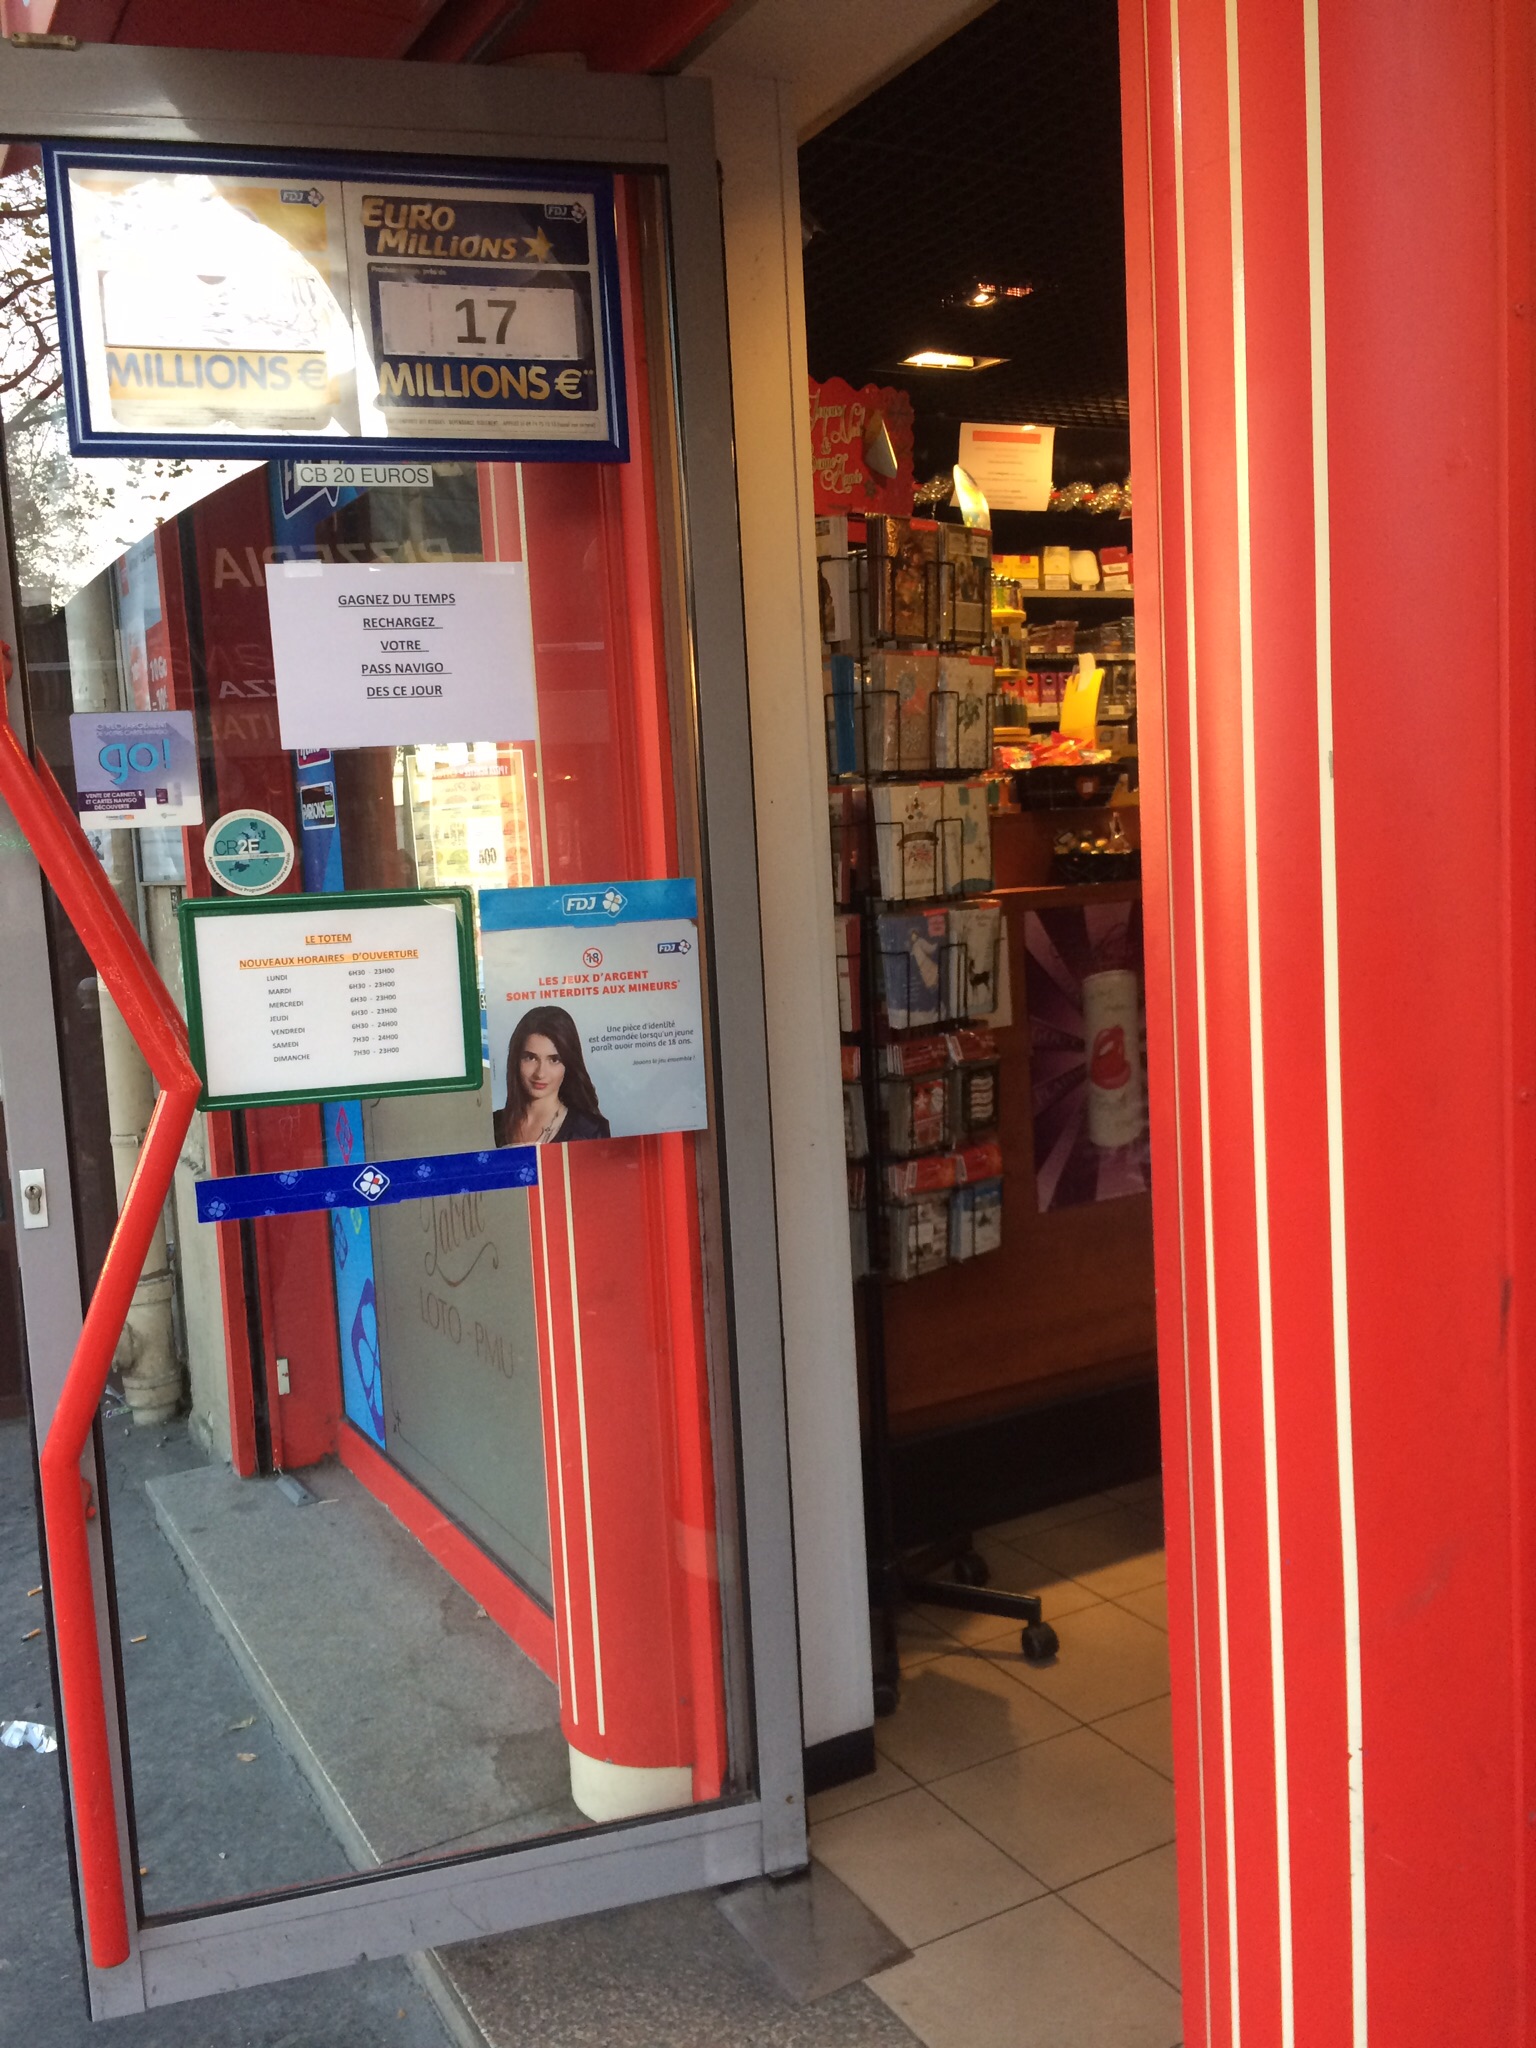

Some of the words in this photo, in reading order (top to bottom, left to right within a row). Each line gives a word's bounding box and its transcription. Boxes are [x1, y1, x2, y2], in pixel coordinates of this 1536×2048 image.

[283, 191, 303, 202] FDJ
[362, 198, 456, 231] EURO
[548, 206, 567, 217] FDJ
[455, 298, 517, 345] 17
[108, 351, 292, 390] MILLIONS
[379, 361, 550, 400] MILLIONS
[300, 466, 327, 484] CB
[334, 466, 355, 484] 20
[361, 467, 430, 484] EUROS
[338, 594, 389, 606] GAGNEZ
[392, 594, 411, 605] DU
[414, 592, 456, 605] TEMPS
[363, 616, 435, 629] RECHARGEZ
[380, 640, 422, 652] VOTRE
[361, 662, 392, 675] PASS
[394, 662, 444, 674] NAVIGO
[366, 686, 390, 698] DES
[392, 686, 408, 697] CE
[410, 684, 442, 697] JOUR
[98, 738, 172, 786] go!
[302, 801, 326, 820] PARIONS
[214, 838, 260, 856] CR2E
[566, 897, 597, 912] FDJ
[305, 936, 316, 944] LE
[318, 934, 352, 944] TOTEM
[658, 944, 676, 952] FDJ
[239, 957, 295, 968] NOUVEAUX
[297, 954, 344, 965] HORAIRES
[352, 949, 419, 962] D'OUVERTURE
[266, 974, 288, 982] LUNDI
[348, 982, 366, 990] 6H30
[374, 980, 395, 988] 23H00
[538, 976, 558, 986] LES
[562, 974, 590, 985] JEUX
[592, 970, 648, 983] D'ARGENT
[506, 990, 536, 1002] SONT
[540, 985, 599, 999] INTERDITS
[602, 983, 626, 995] AUX
[269, 1000, 304, 1009] MERCREDI
[270, 1014, 288, 1022] JEUDI
[271, 1028, 305, 1036] VENDREDI
[352, 1022, 369, 1030] 6H30
[377, 1020, 398, 1028] 24H00
[606, 1024, 620, 1032] Une
[622, 1023, 641, 1033] pièce
[642, 1020, 676, 1032] d'identité
[588, 1036, 600, 1044] est
[600, 1032, 638, 1042] demandée
[639, 1030, 673, 1042] lorsqu'un
[674, 1028, 694, 1040] jeune
[272, 1041, 299, 1049] SAMEDI
[590, 1042, 614, 1054] paraît
[615, 1042, 633, 1051] avoir
[634, 1040, 656, 1048] moins
[658, 1039, 667, 1047] de
[668, 1038, 676, 1046] 18
[678, 1038, 692, 1046] ans.
[274, 1054, 310, 1062] DIMANCHE
[378, 1046, 400, 1054] 23H00
[419, 1286, 462, 1345] LOTO
[474, 1320, 514, 1379] PMU
